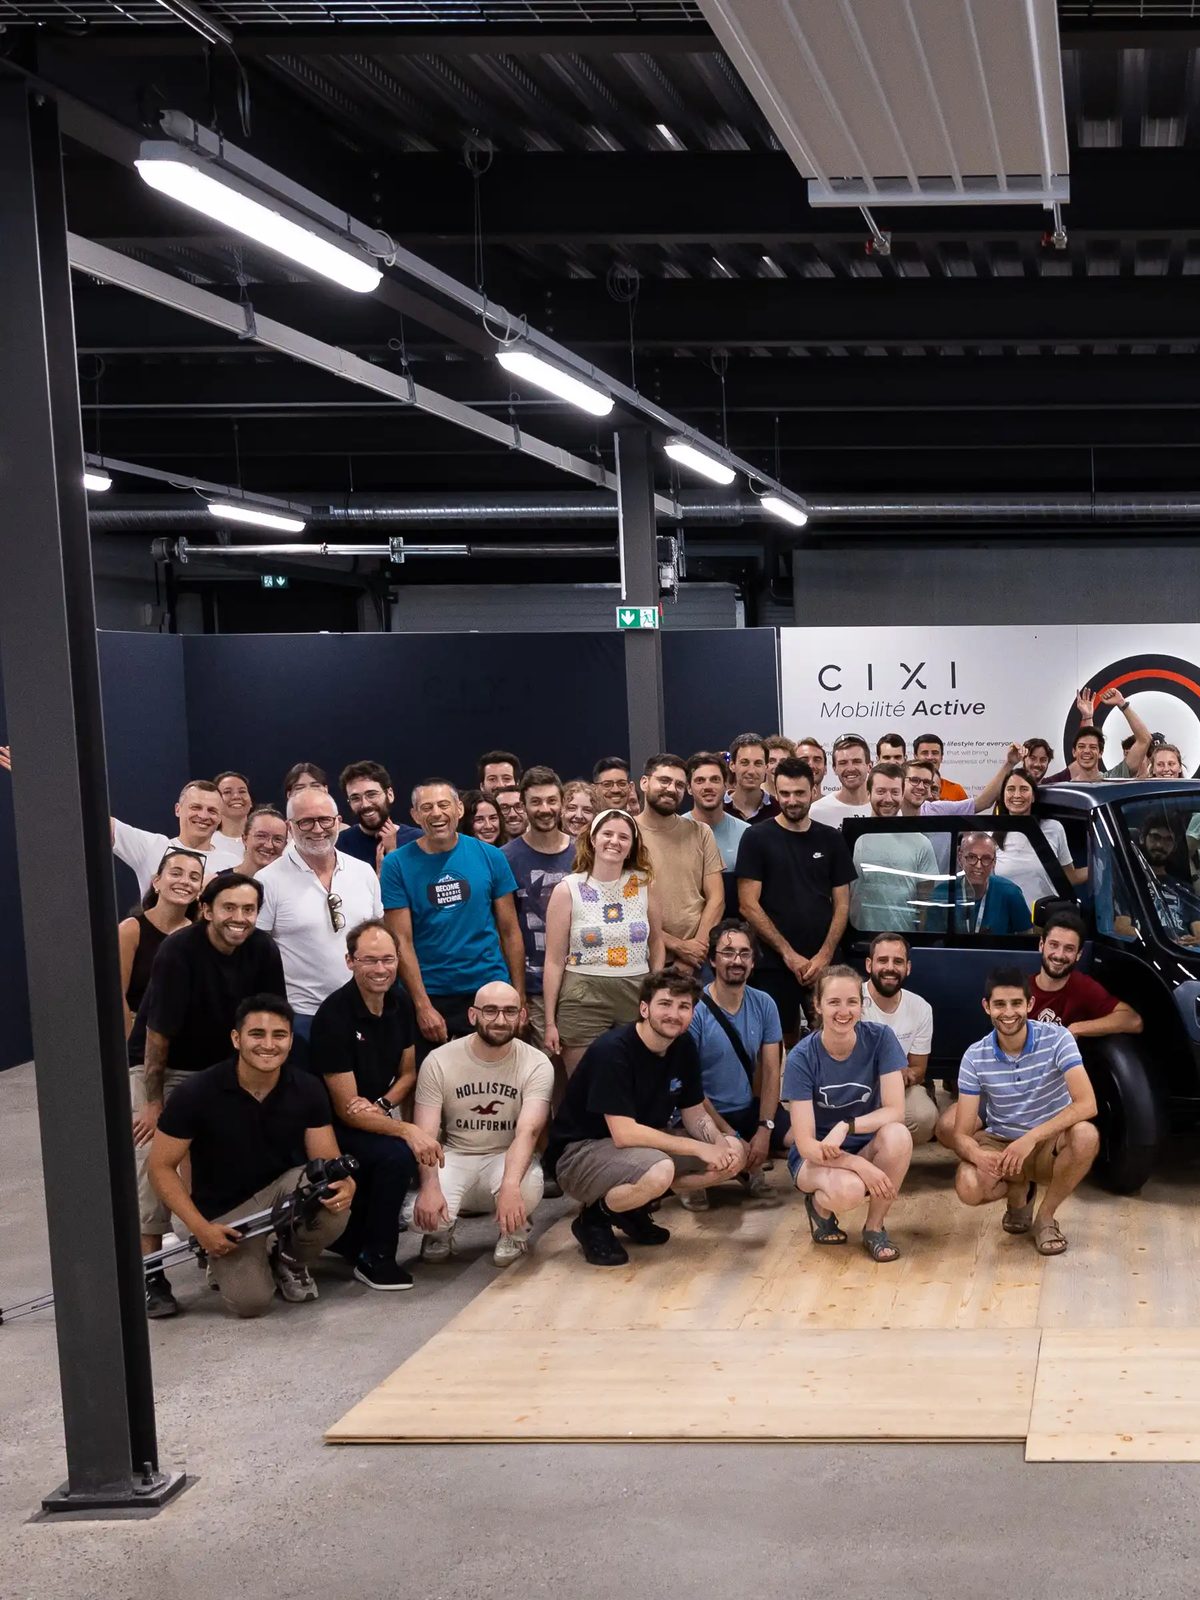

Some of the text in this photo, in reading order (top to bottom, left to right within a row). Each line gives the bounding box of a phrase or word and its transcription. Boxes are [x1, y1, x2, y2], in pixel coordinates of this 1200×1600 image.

[818, 661, 956, 691] CIXI
[820, 699, 986, 718] Mobilité Active
[435, 882, 461, 893] BECOME
[456, 1082, 518, 1099] HOLLISTER
